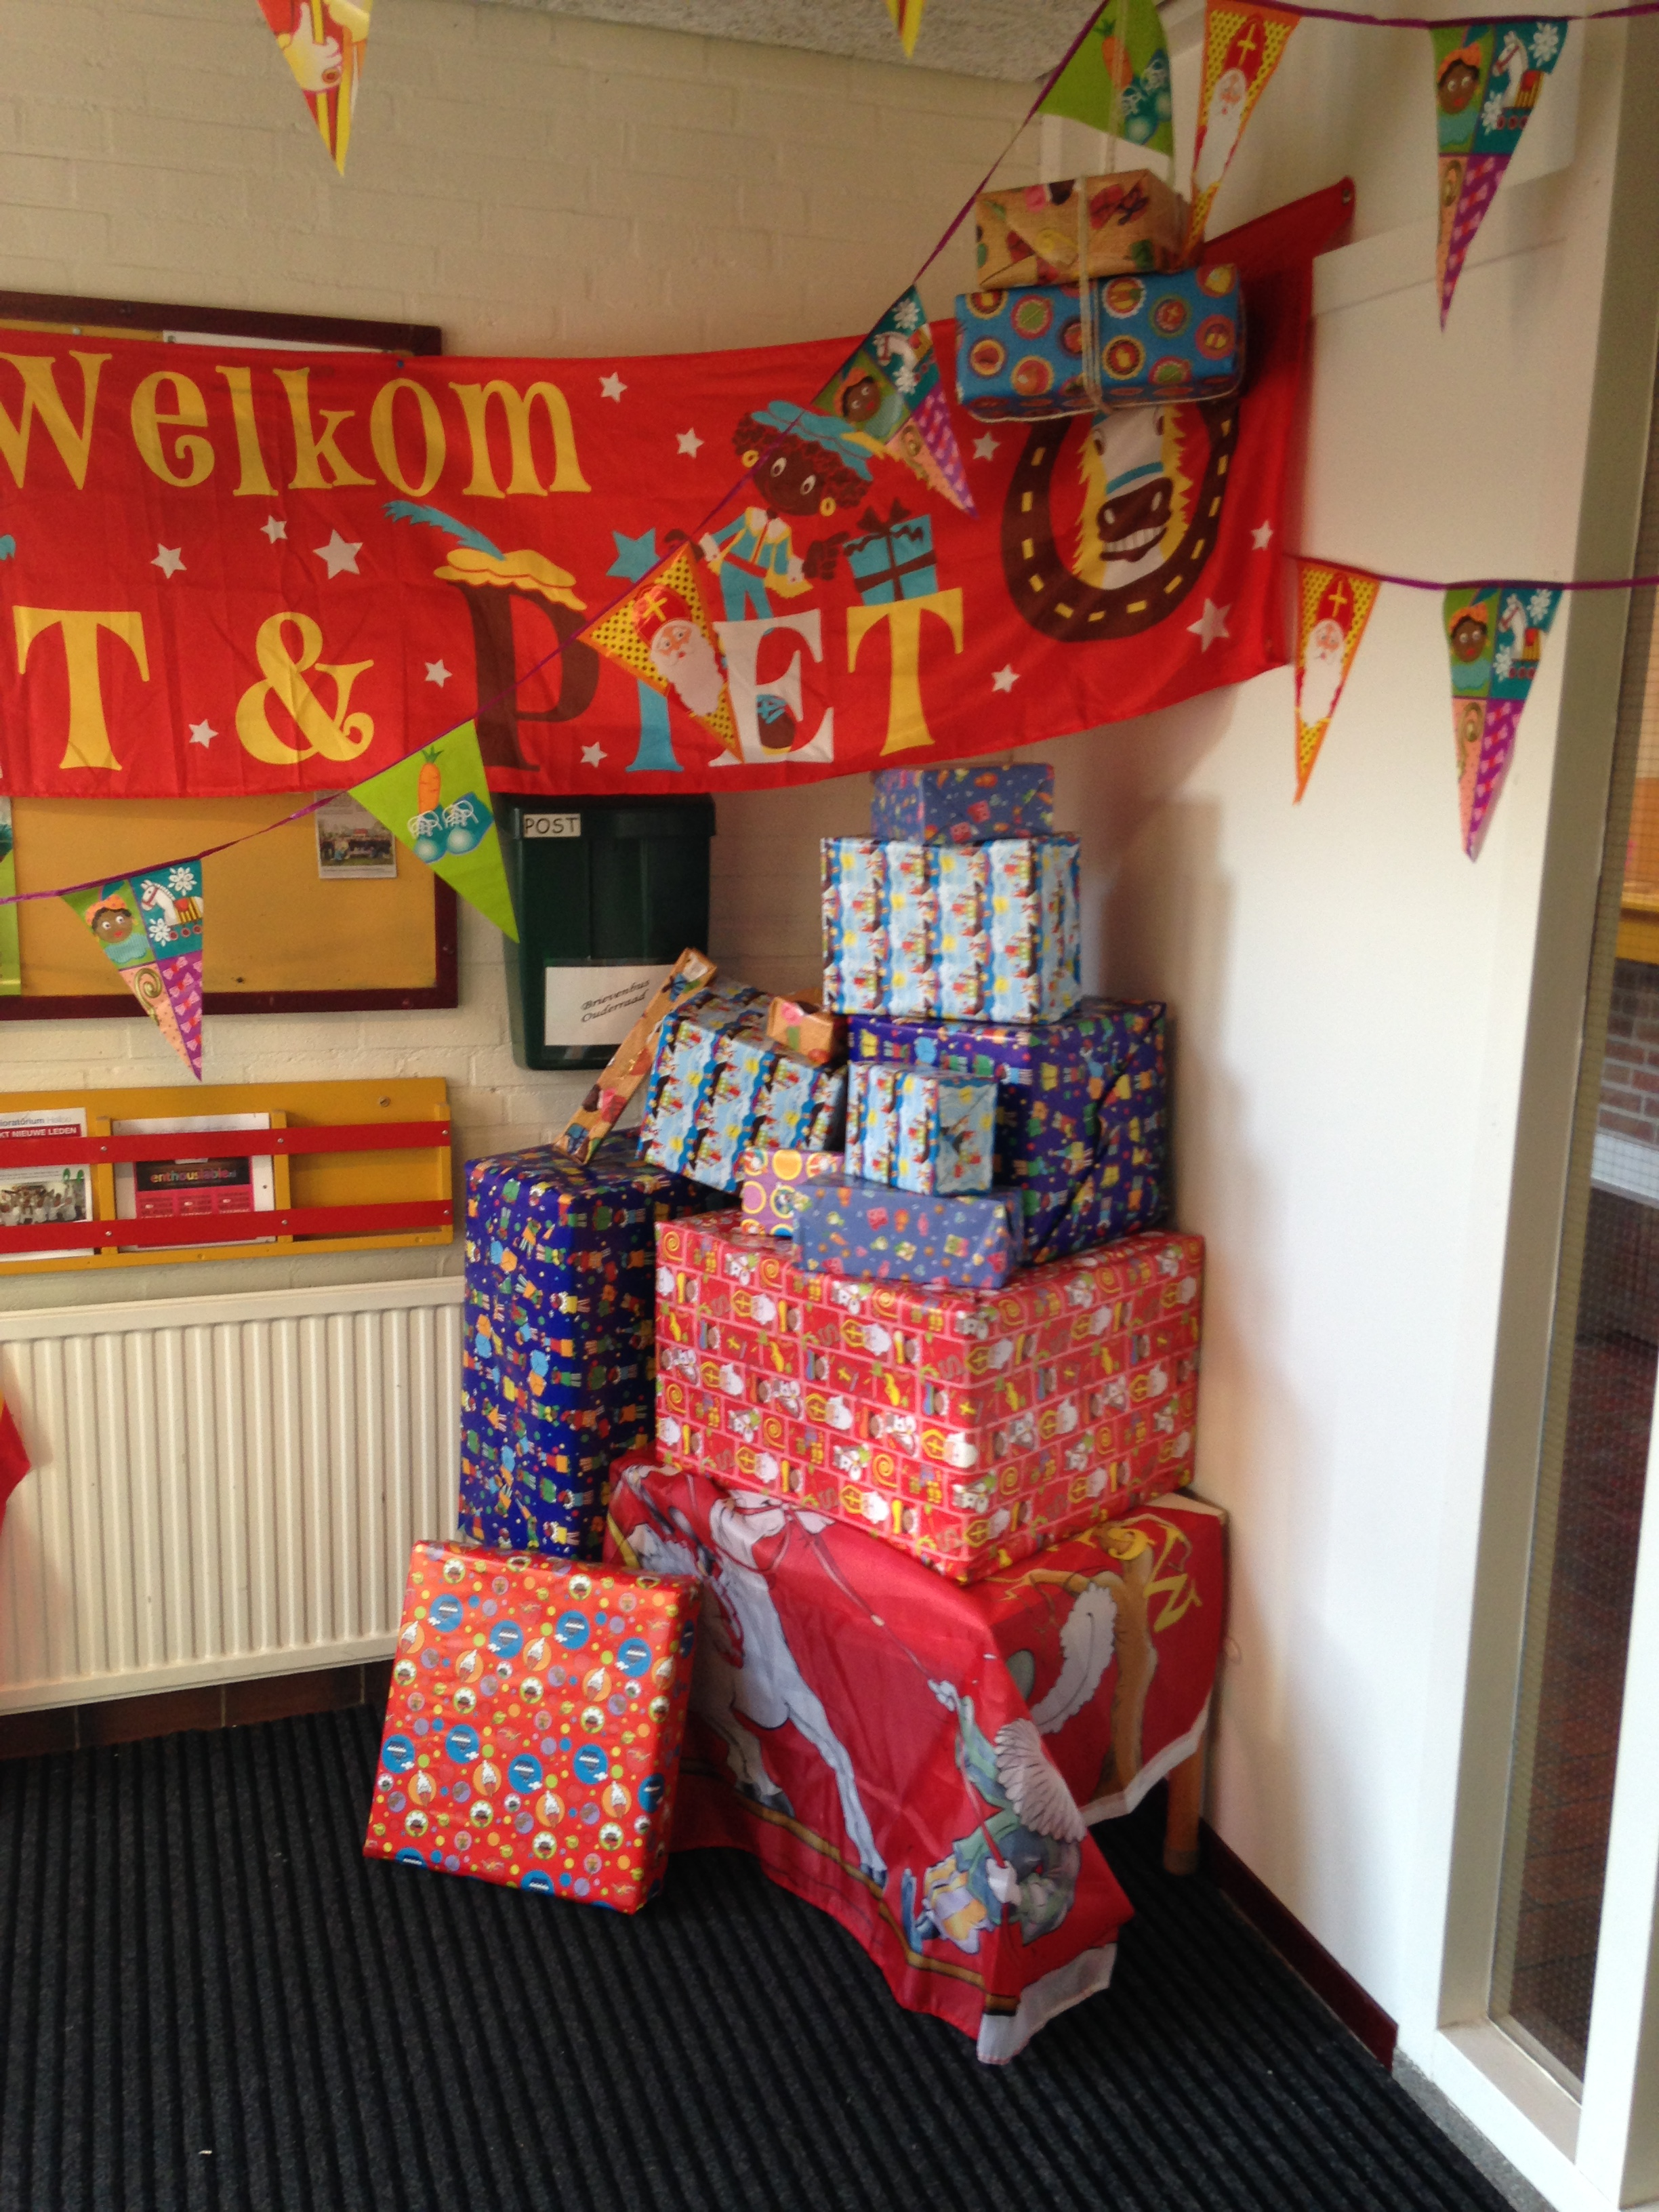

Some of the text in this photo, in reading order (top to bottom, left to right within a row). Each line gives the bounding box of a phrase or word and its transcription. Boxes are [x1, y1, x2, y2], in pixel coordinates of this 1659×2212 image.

[0, 350, 592, 499] Welkom
[234, 611, 375, 765] &
[525, 817, 579, 834] POST
[47, 1127, 77, 1136] LEDEN
